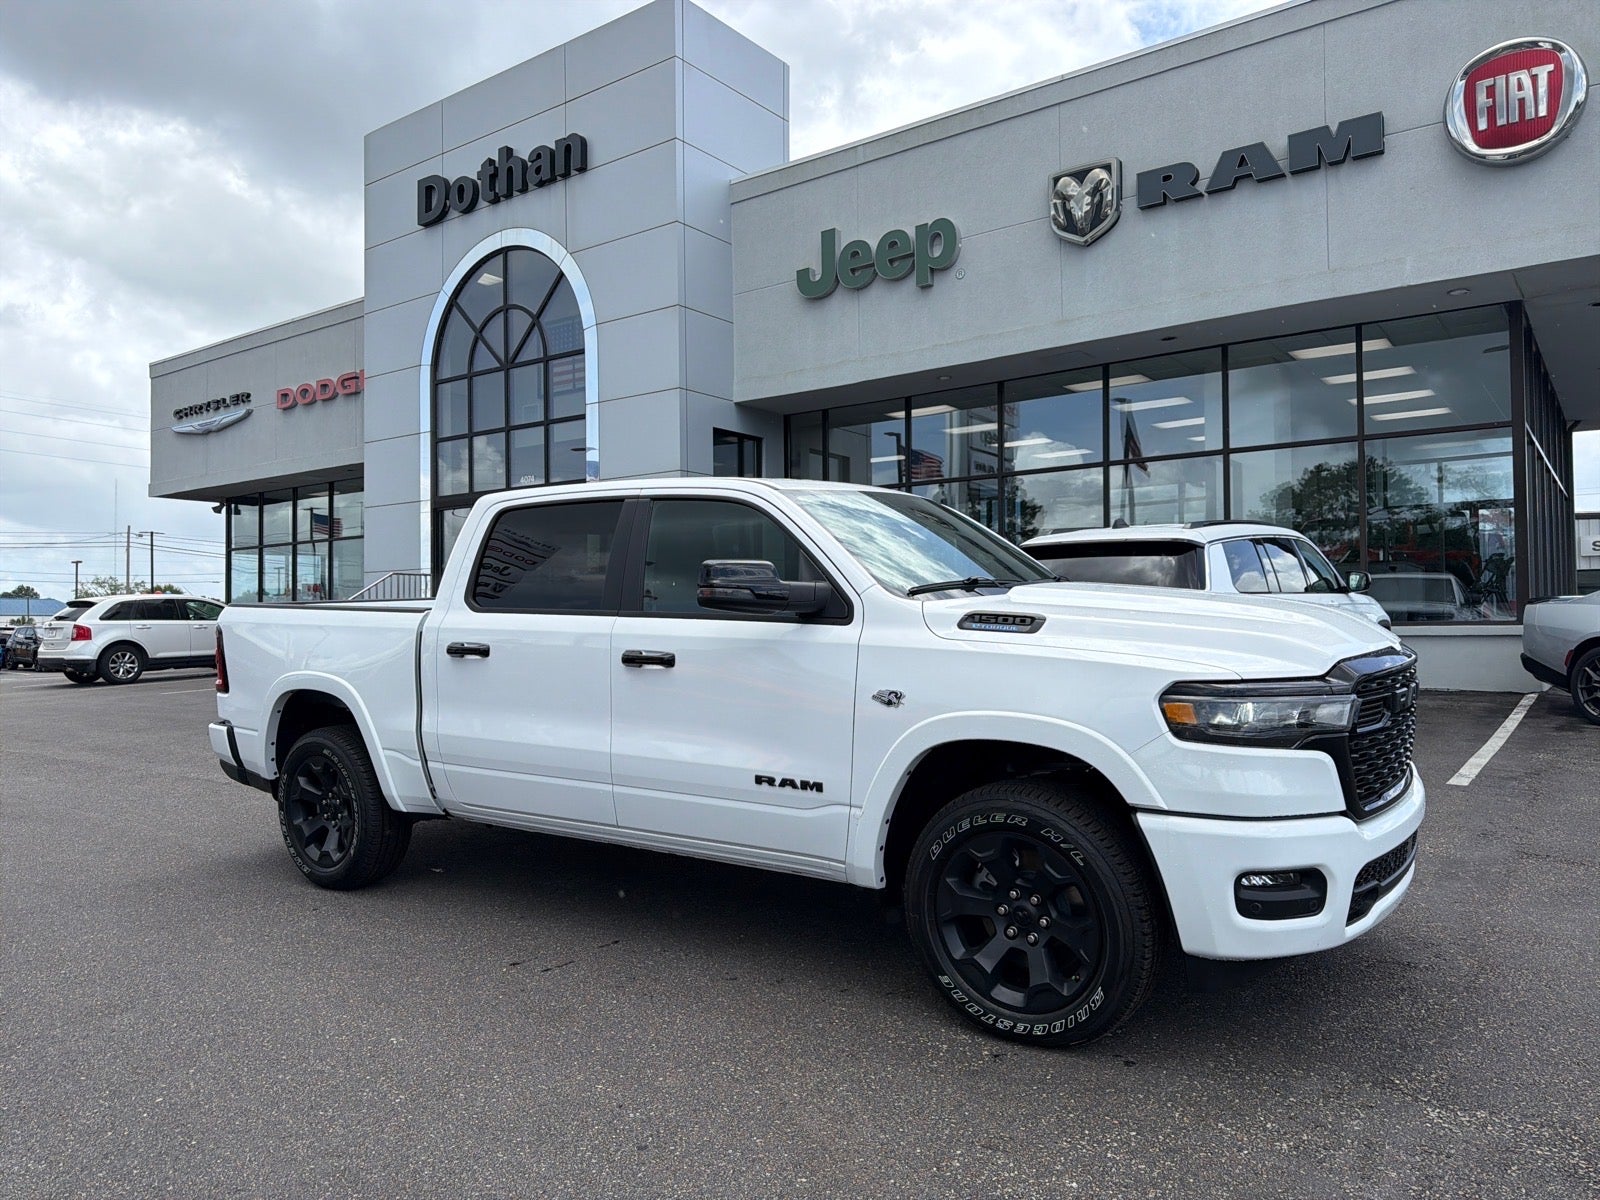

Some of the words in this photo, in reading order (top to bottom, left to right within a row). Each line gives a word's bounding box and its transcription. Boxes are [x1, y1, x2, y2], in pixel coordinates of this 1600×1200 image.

[1475, 63, 1555, 131] FIAT
[416, 132, 588, 227] Dothan
[1136, 111, 1385, 210] RAM
[796, 217, 961, 299] Jeep
[173, 391, 252, 421] CHRYSLER
[966, 614, 1031, 625] 1500
[754, 774, 823, 793] RAM
[929, 813, 1028, 860] DUELER
[1041, 827, 1085, 866] H/L
[938, 975, 1105, 1036] BRIDGESTONE
